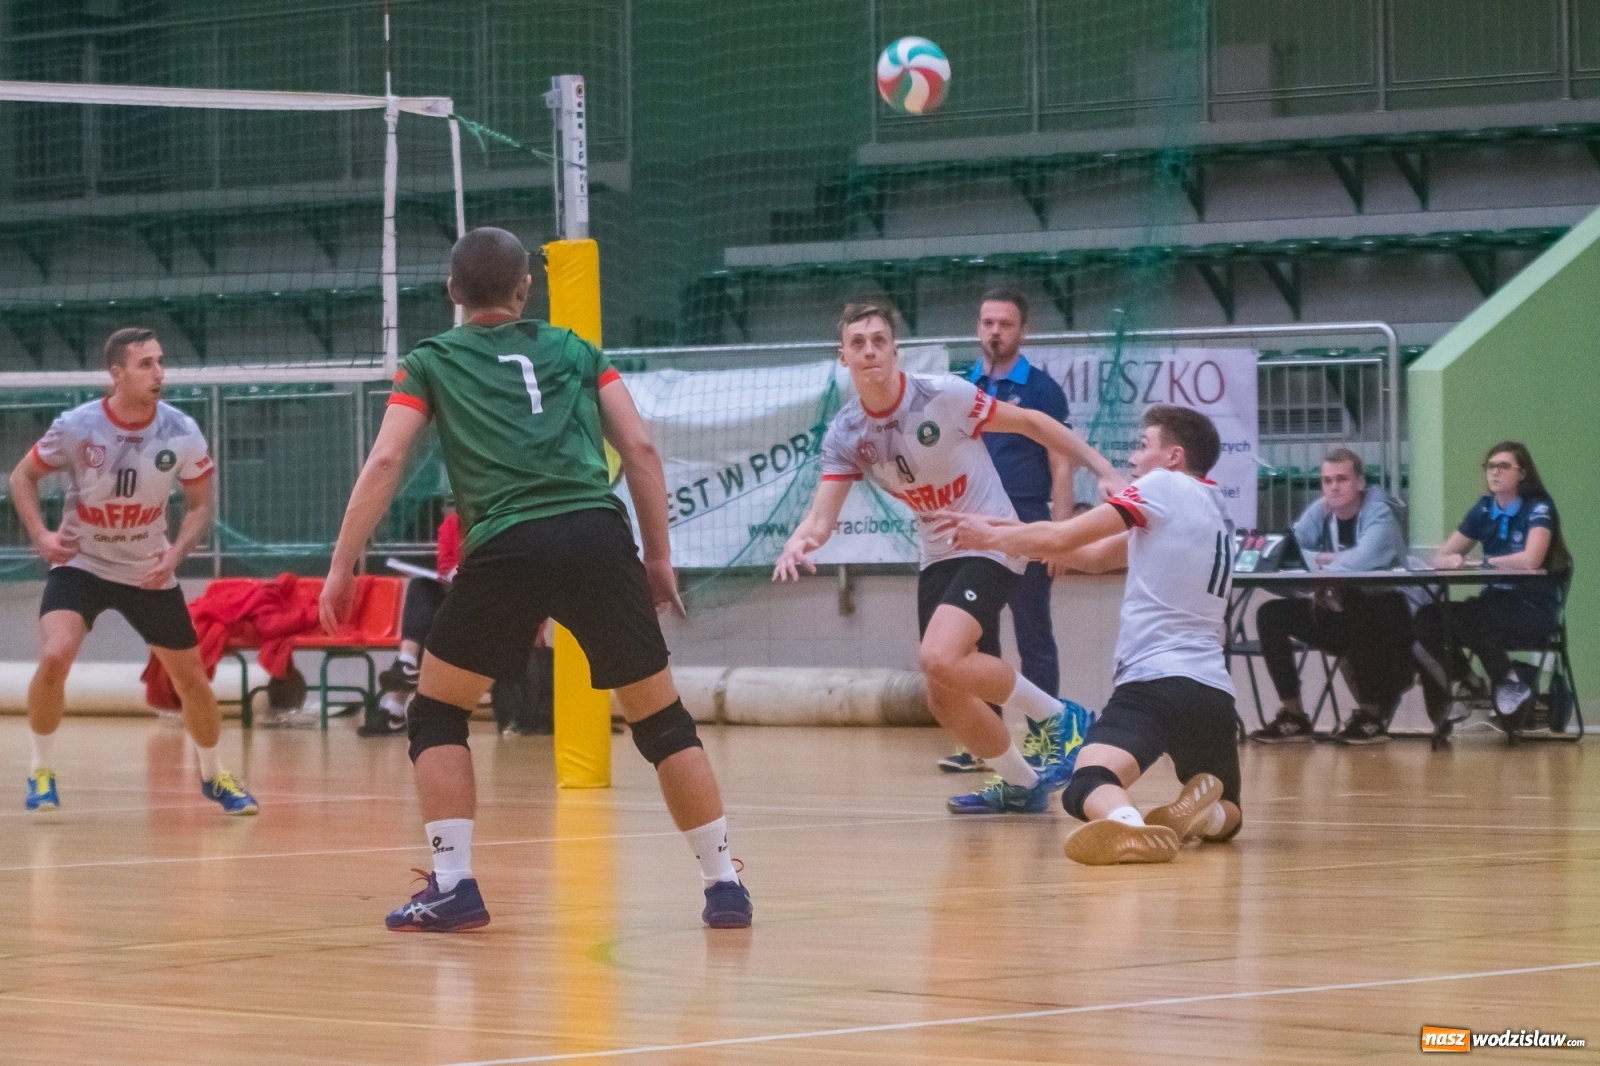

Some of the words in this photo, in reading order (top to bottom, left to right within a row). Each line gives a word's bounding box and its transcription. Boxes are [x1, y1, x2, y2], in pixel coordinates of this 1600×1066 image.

[497, 353, 543, 414] 7
[1042, 360, 1225, 405] MIESZKO
[115, 468, 137, 498] 10
[716, 463, 745, 497] W
[895, 455, 915, 483] 9
[1207, 530, 1231, 598] 11
